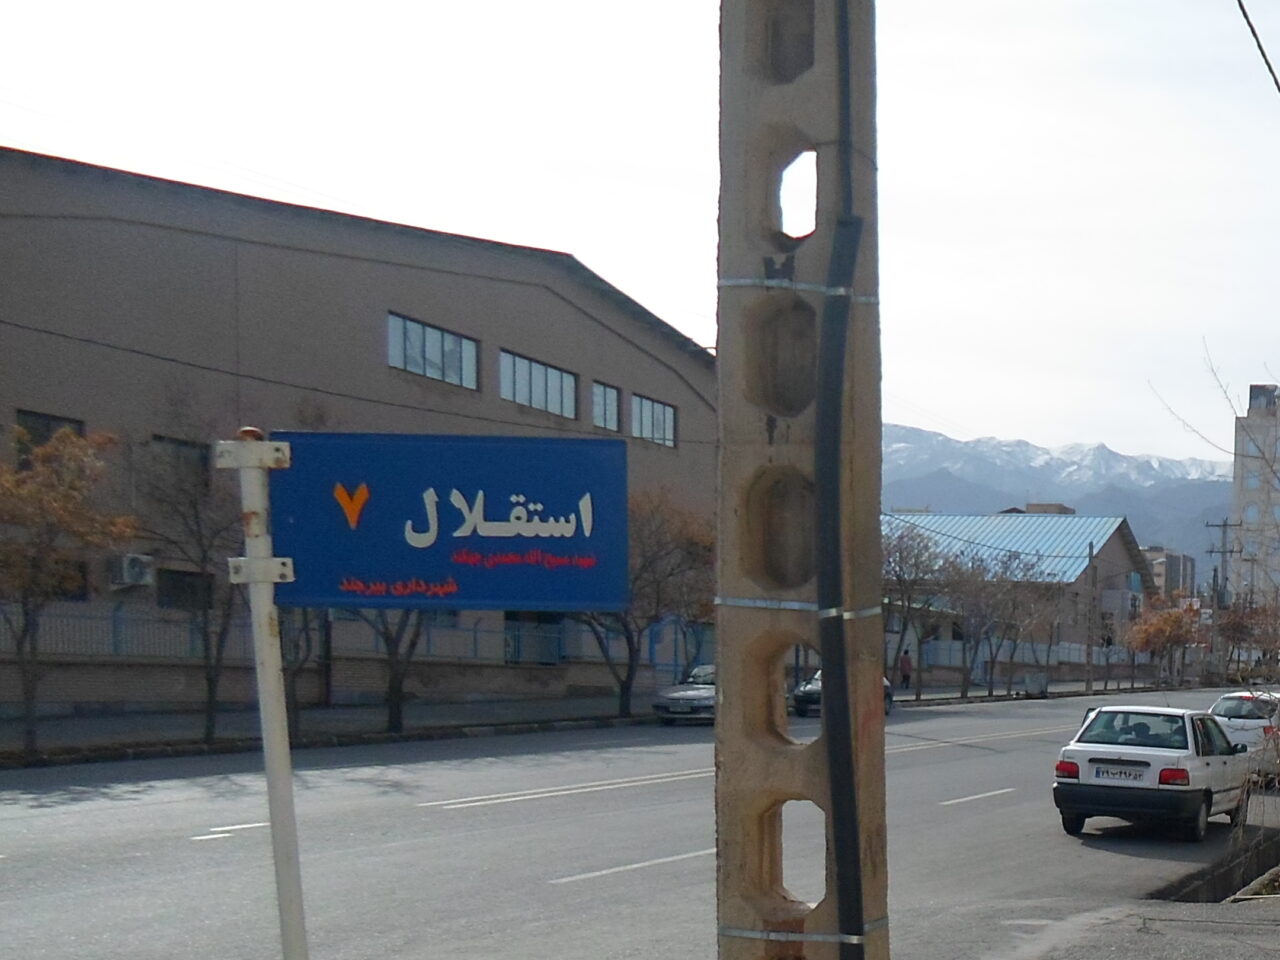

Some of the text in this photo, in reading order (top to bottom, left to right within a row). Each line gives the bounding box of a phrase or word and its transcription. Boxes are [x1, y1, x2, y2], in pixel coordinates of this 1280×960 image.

[333, 482, 594, 549] استقلال ۷
[338, 577, 459, 597] شهرداری بیرجند
